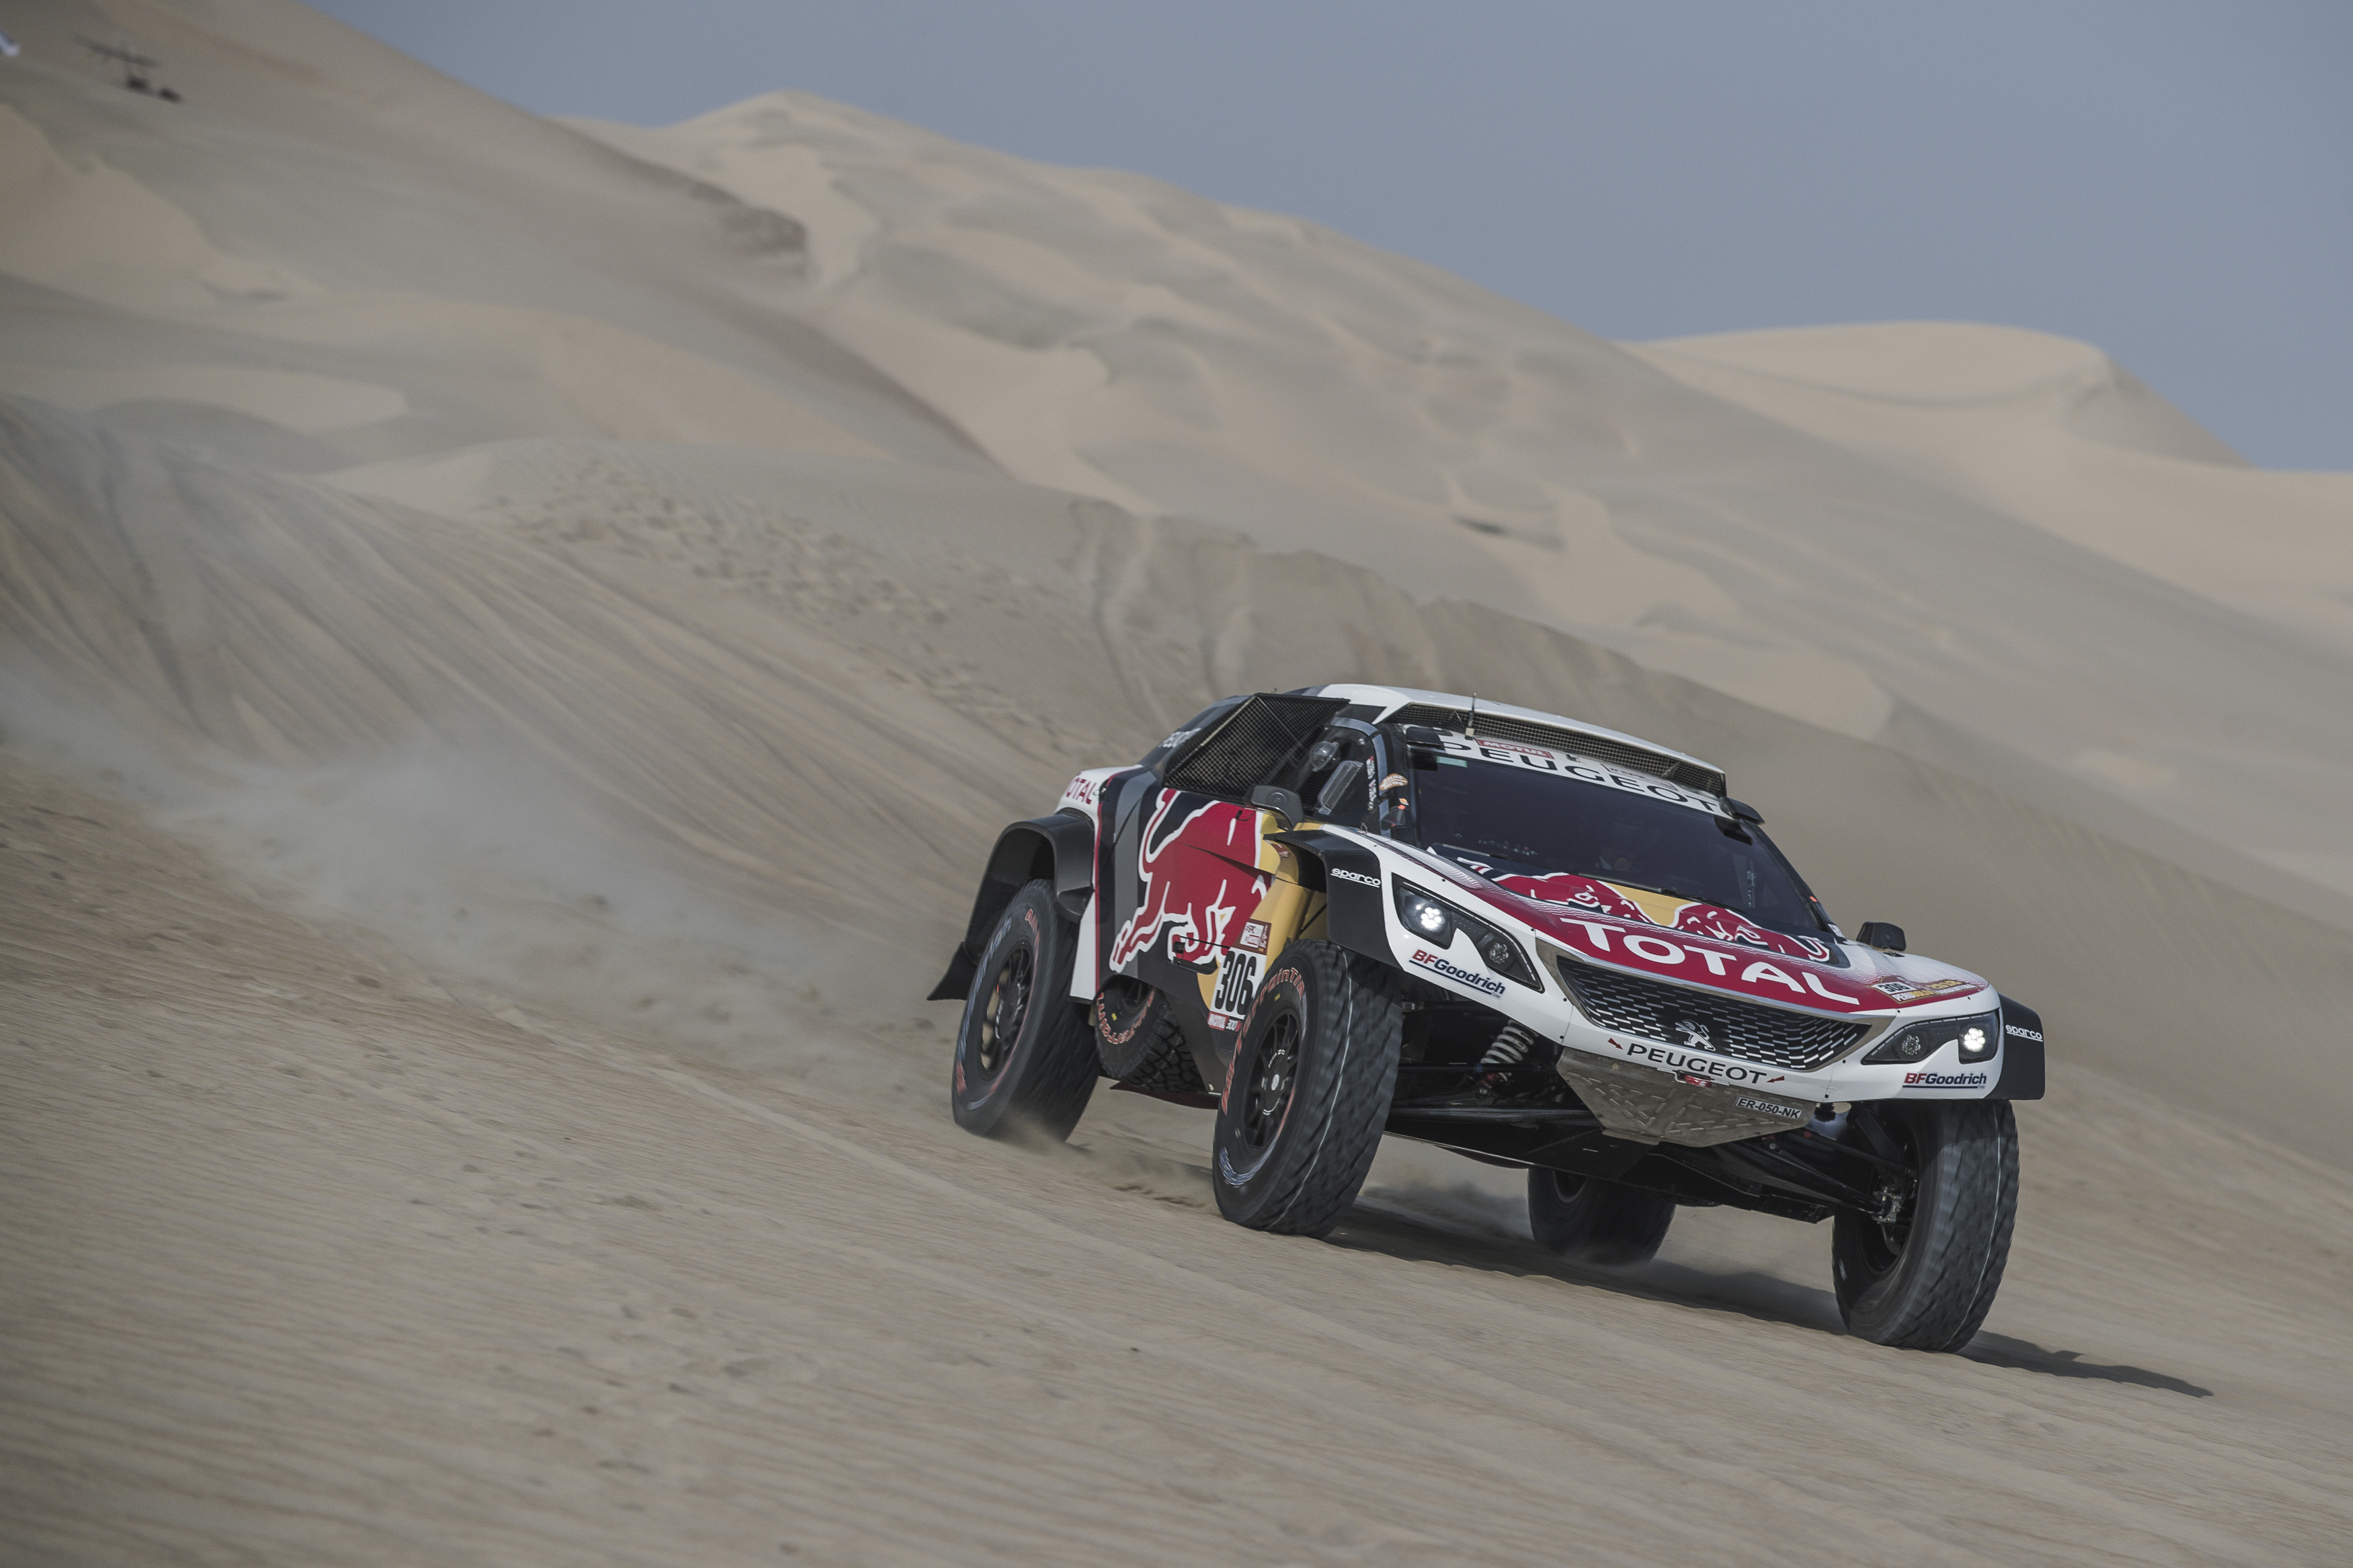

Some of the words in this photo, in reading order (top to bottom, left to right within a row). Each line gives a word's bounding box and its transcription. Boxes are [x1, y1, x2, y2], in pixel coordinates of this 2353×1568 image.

[1483, 741, 1549, 756] MOTUL
[1331, 868, 1382, 886] sparco
[1559, 917, 1861, 1005] TOTAL
[1411, 948, 1506, 995] BFGoodrich
[1214, 951, 1257, 1016] 306
[1878, 983, 1911, 992] 306
[1891, 991, 1916, 1002] PERU
[2005, 1024, 2043, 1041] sparco
[1626, 1042, 1767, 1084] PEUGEOT
[1903, 1073, 1987, 1085] BFGoodrich
[1737, 1098, 1802, 1119] ER-050-NK
